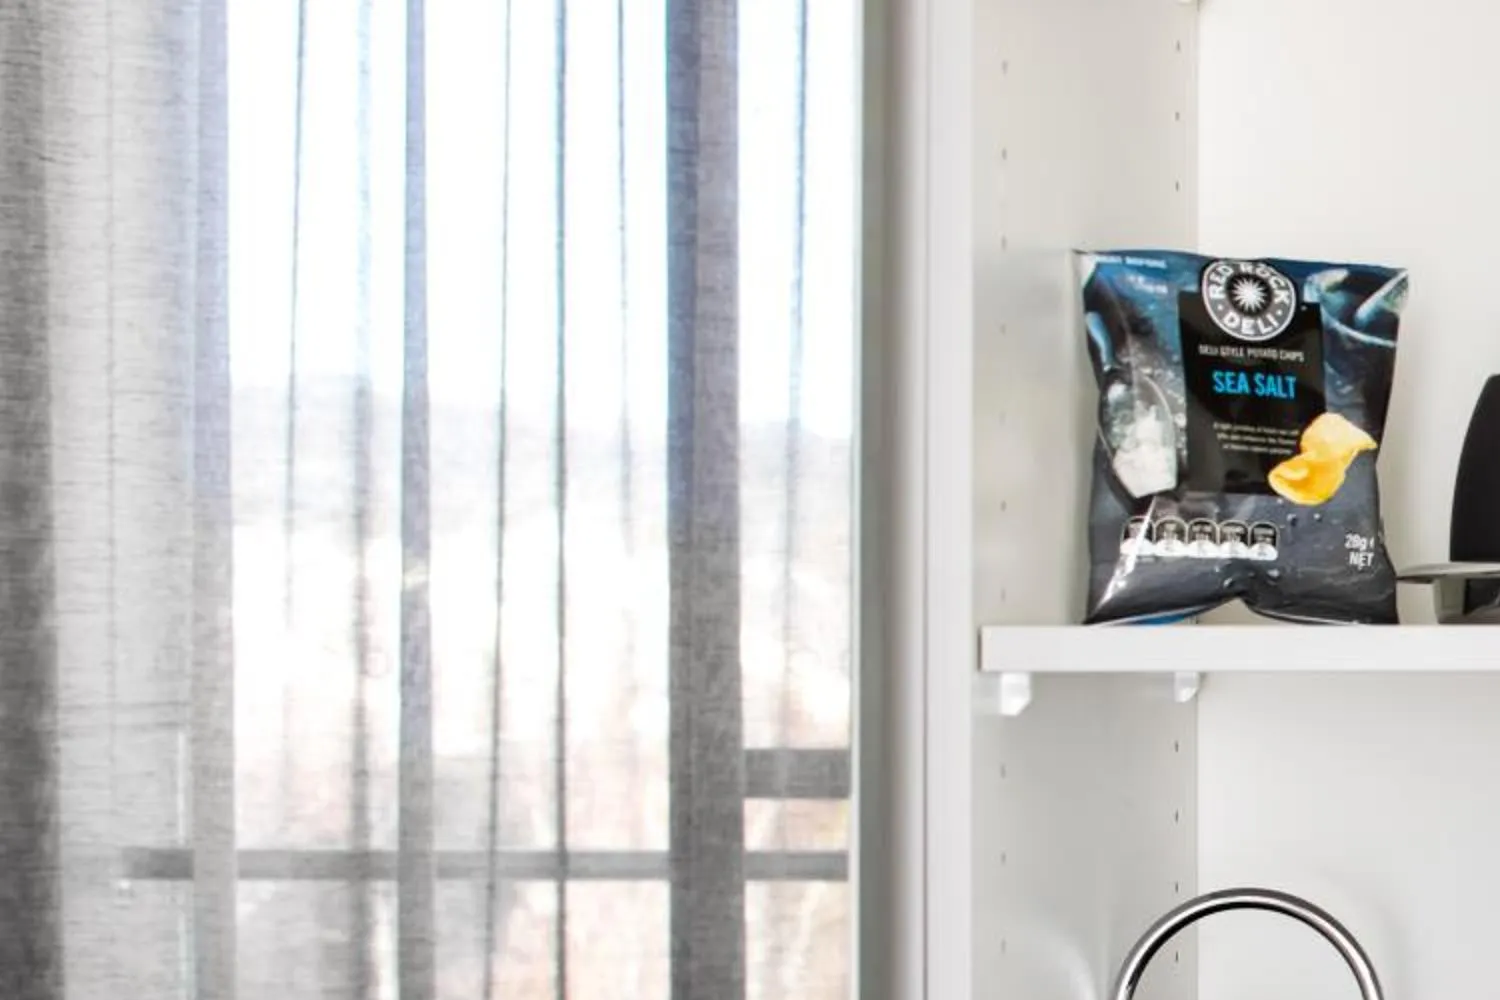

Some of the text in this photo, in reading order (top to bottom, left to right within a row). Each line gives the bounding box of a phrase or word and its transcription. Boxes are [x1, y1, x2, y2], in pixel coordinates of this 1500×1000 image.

[1208, 265, 1234, 299] RED
[1222, 312, 1279, 335] DELI
[1212, 370, 1296, 399] SEA SALT
